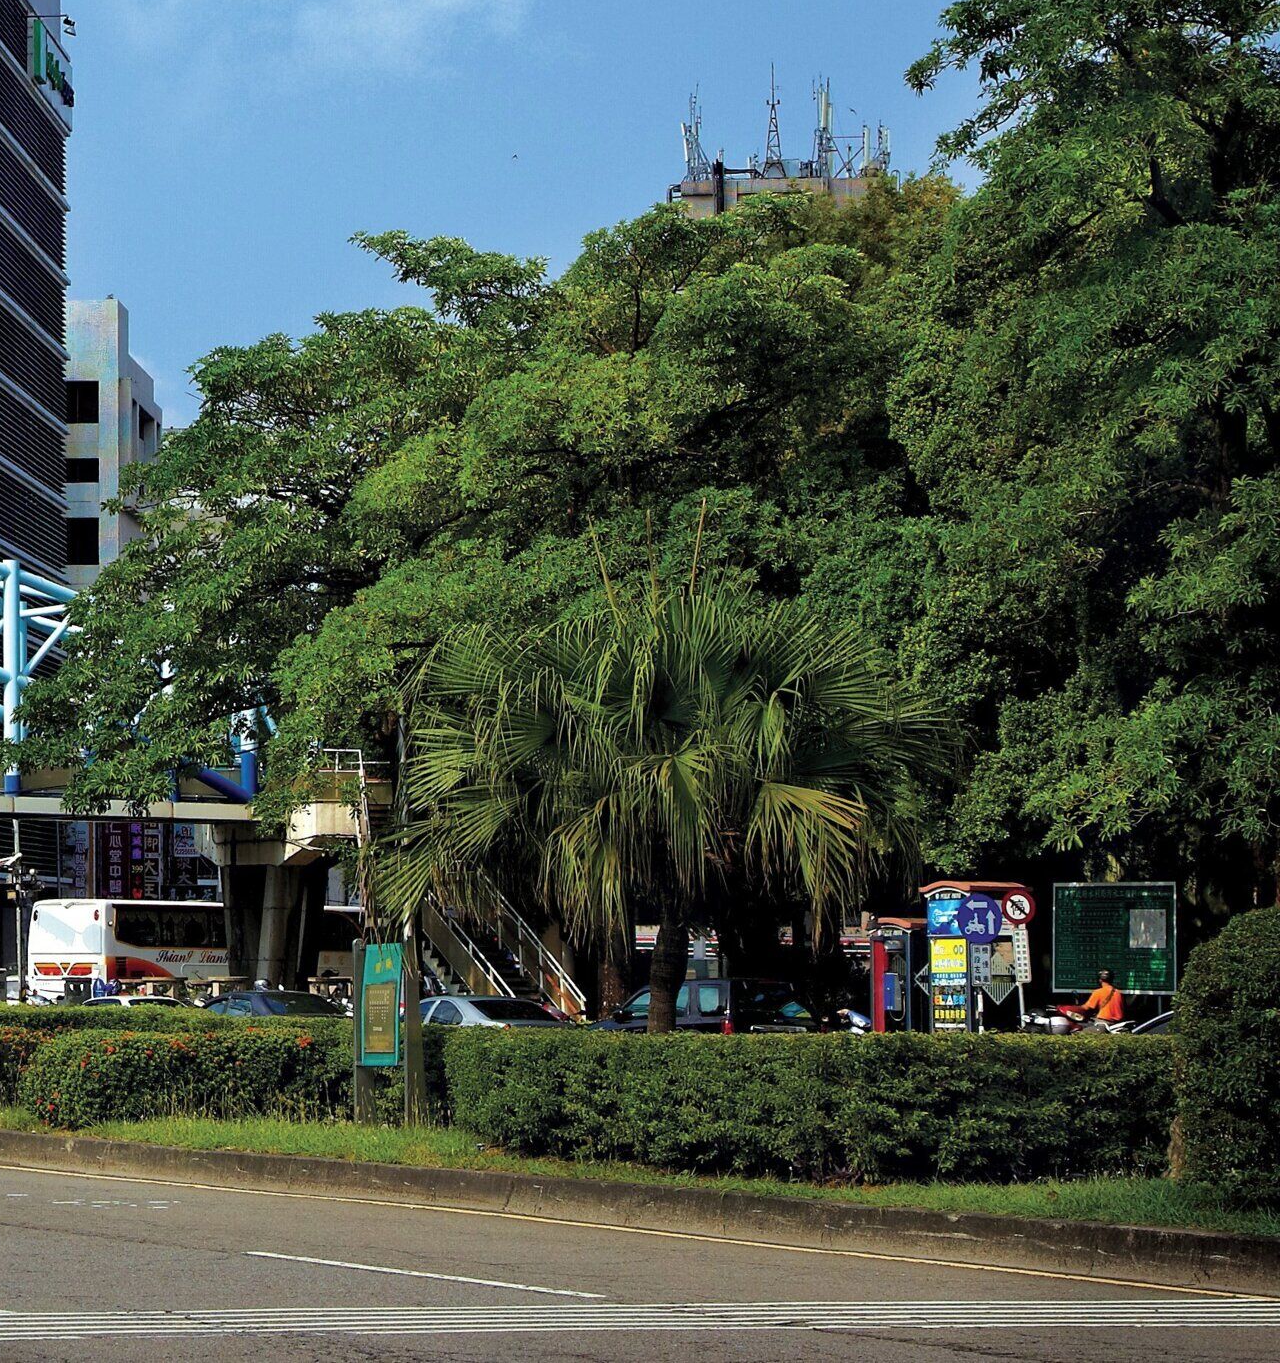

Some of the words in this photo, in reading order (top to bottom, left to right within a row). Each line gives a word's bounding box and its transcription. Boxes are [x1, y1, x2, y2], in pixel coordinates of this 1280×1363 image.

[108, 822, 123, 899] 仁心堂中醫
